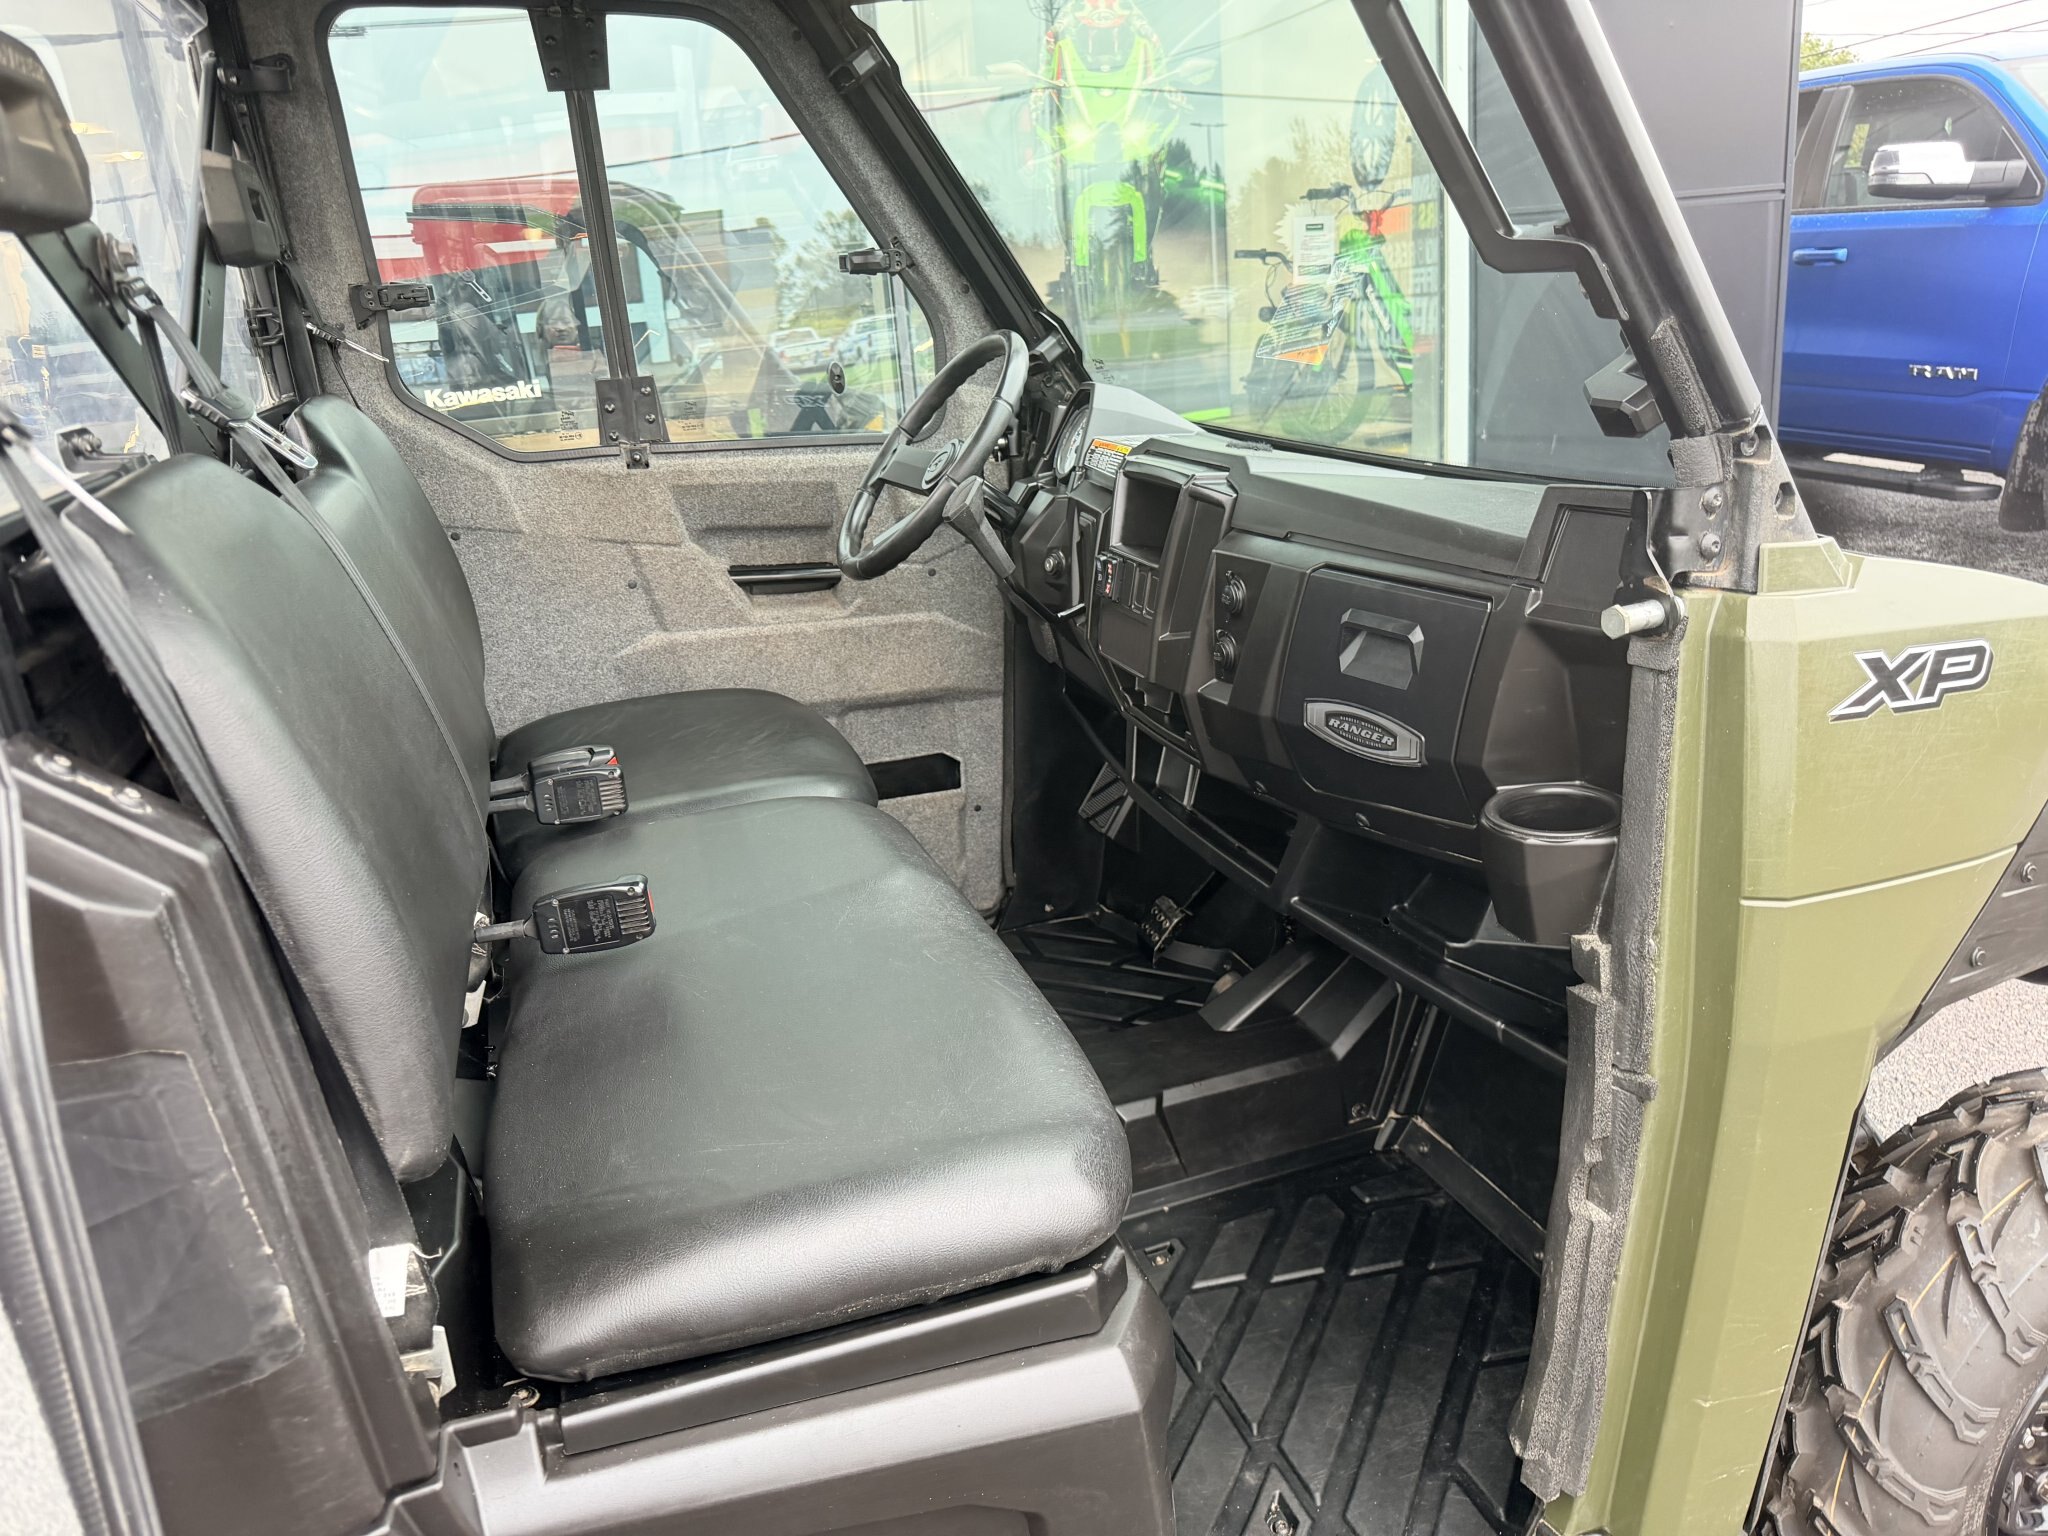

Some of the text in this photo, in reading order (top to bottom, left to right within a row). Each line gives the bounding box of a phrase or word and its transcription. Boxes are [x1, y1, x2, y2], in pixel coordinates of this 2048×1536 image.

[1909, 364, 1979, 381] RAM
[424, 381, 542, 409] Kawasaki
[1827, 638, 1994, 724] XP
[1328, 718, 1395, 746] RANGER
